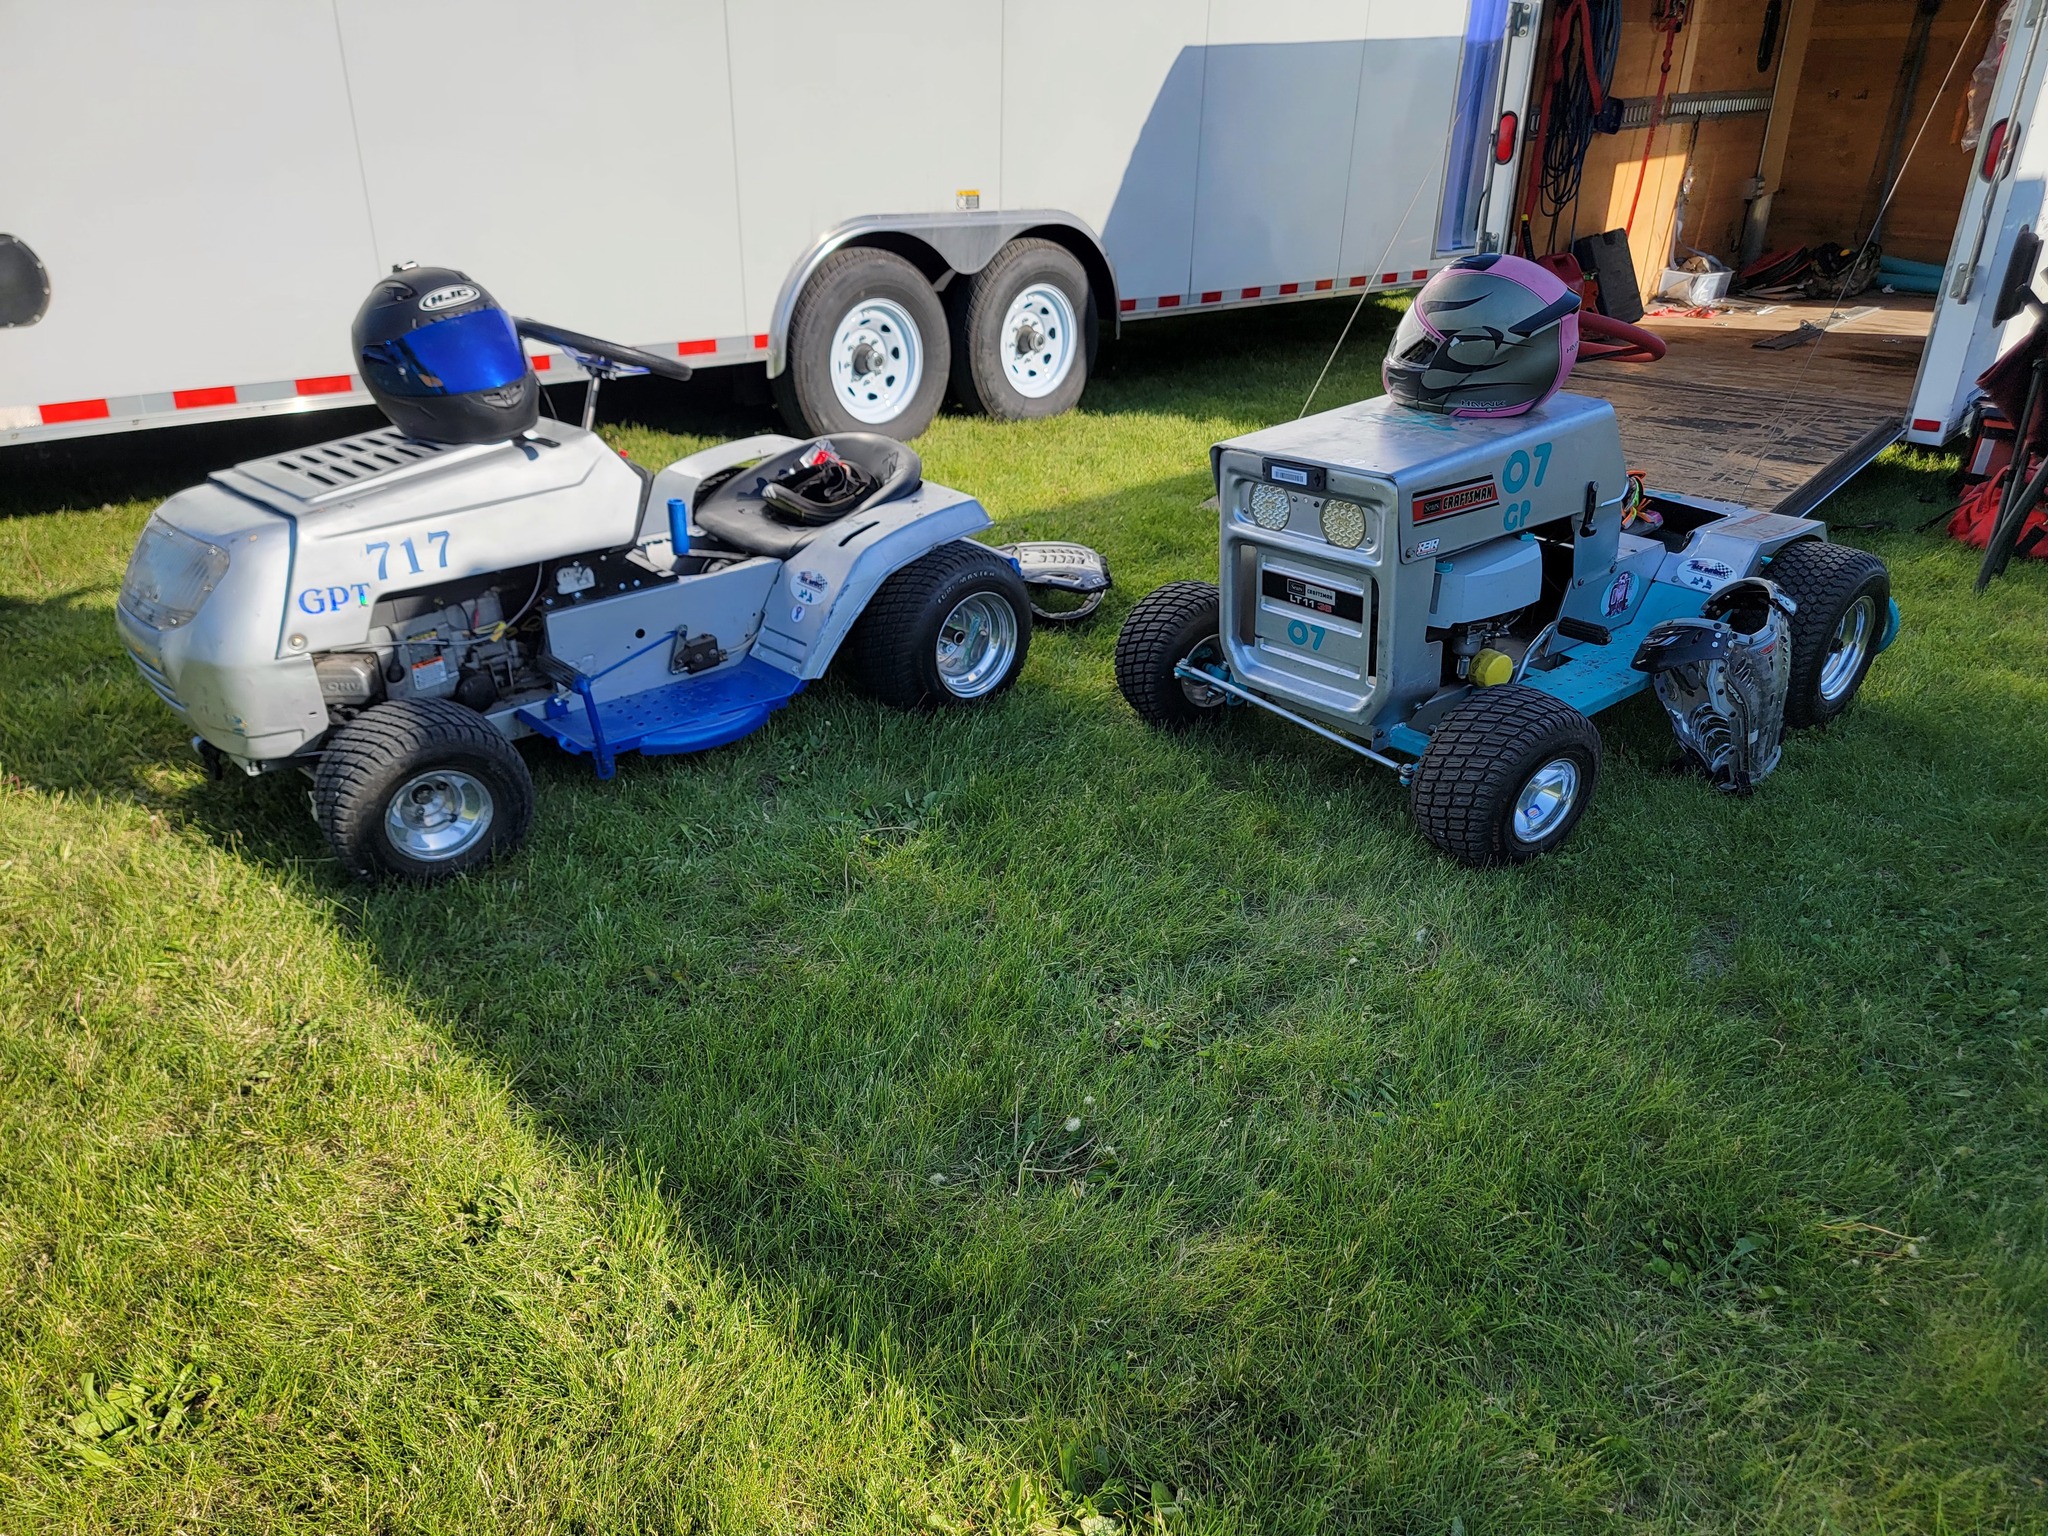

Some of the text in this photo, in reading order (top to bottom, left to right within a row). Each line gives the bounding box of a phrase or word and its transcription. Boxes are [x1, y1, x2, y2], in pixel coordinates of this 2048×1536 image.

[430, 288, 470, 304] HJC
[1460, 399, 1506, 408] HAWK
[1502, 442, 1552, 494] 07
[1424, 484, 1493, 513] Sears CRAFTSMAN
[1503, 500, 1531, 531] GP
[366, 531, 450, 580] 717
[298, 583, 371, 615] GPT
[1306, 588, 1333, 601] CRAFTSMAN
[1287, 619, 1326, 651] 07
